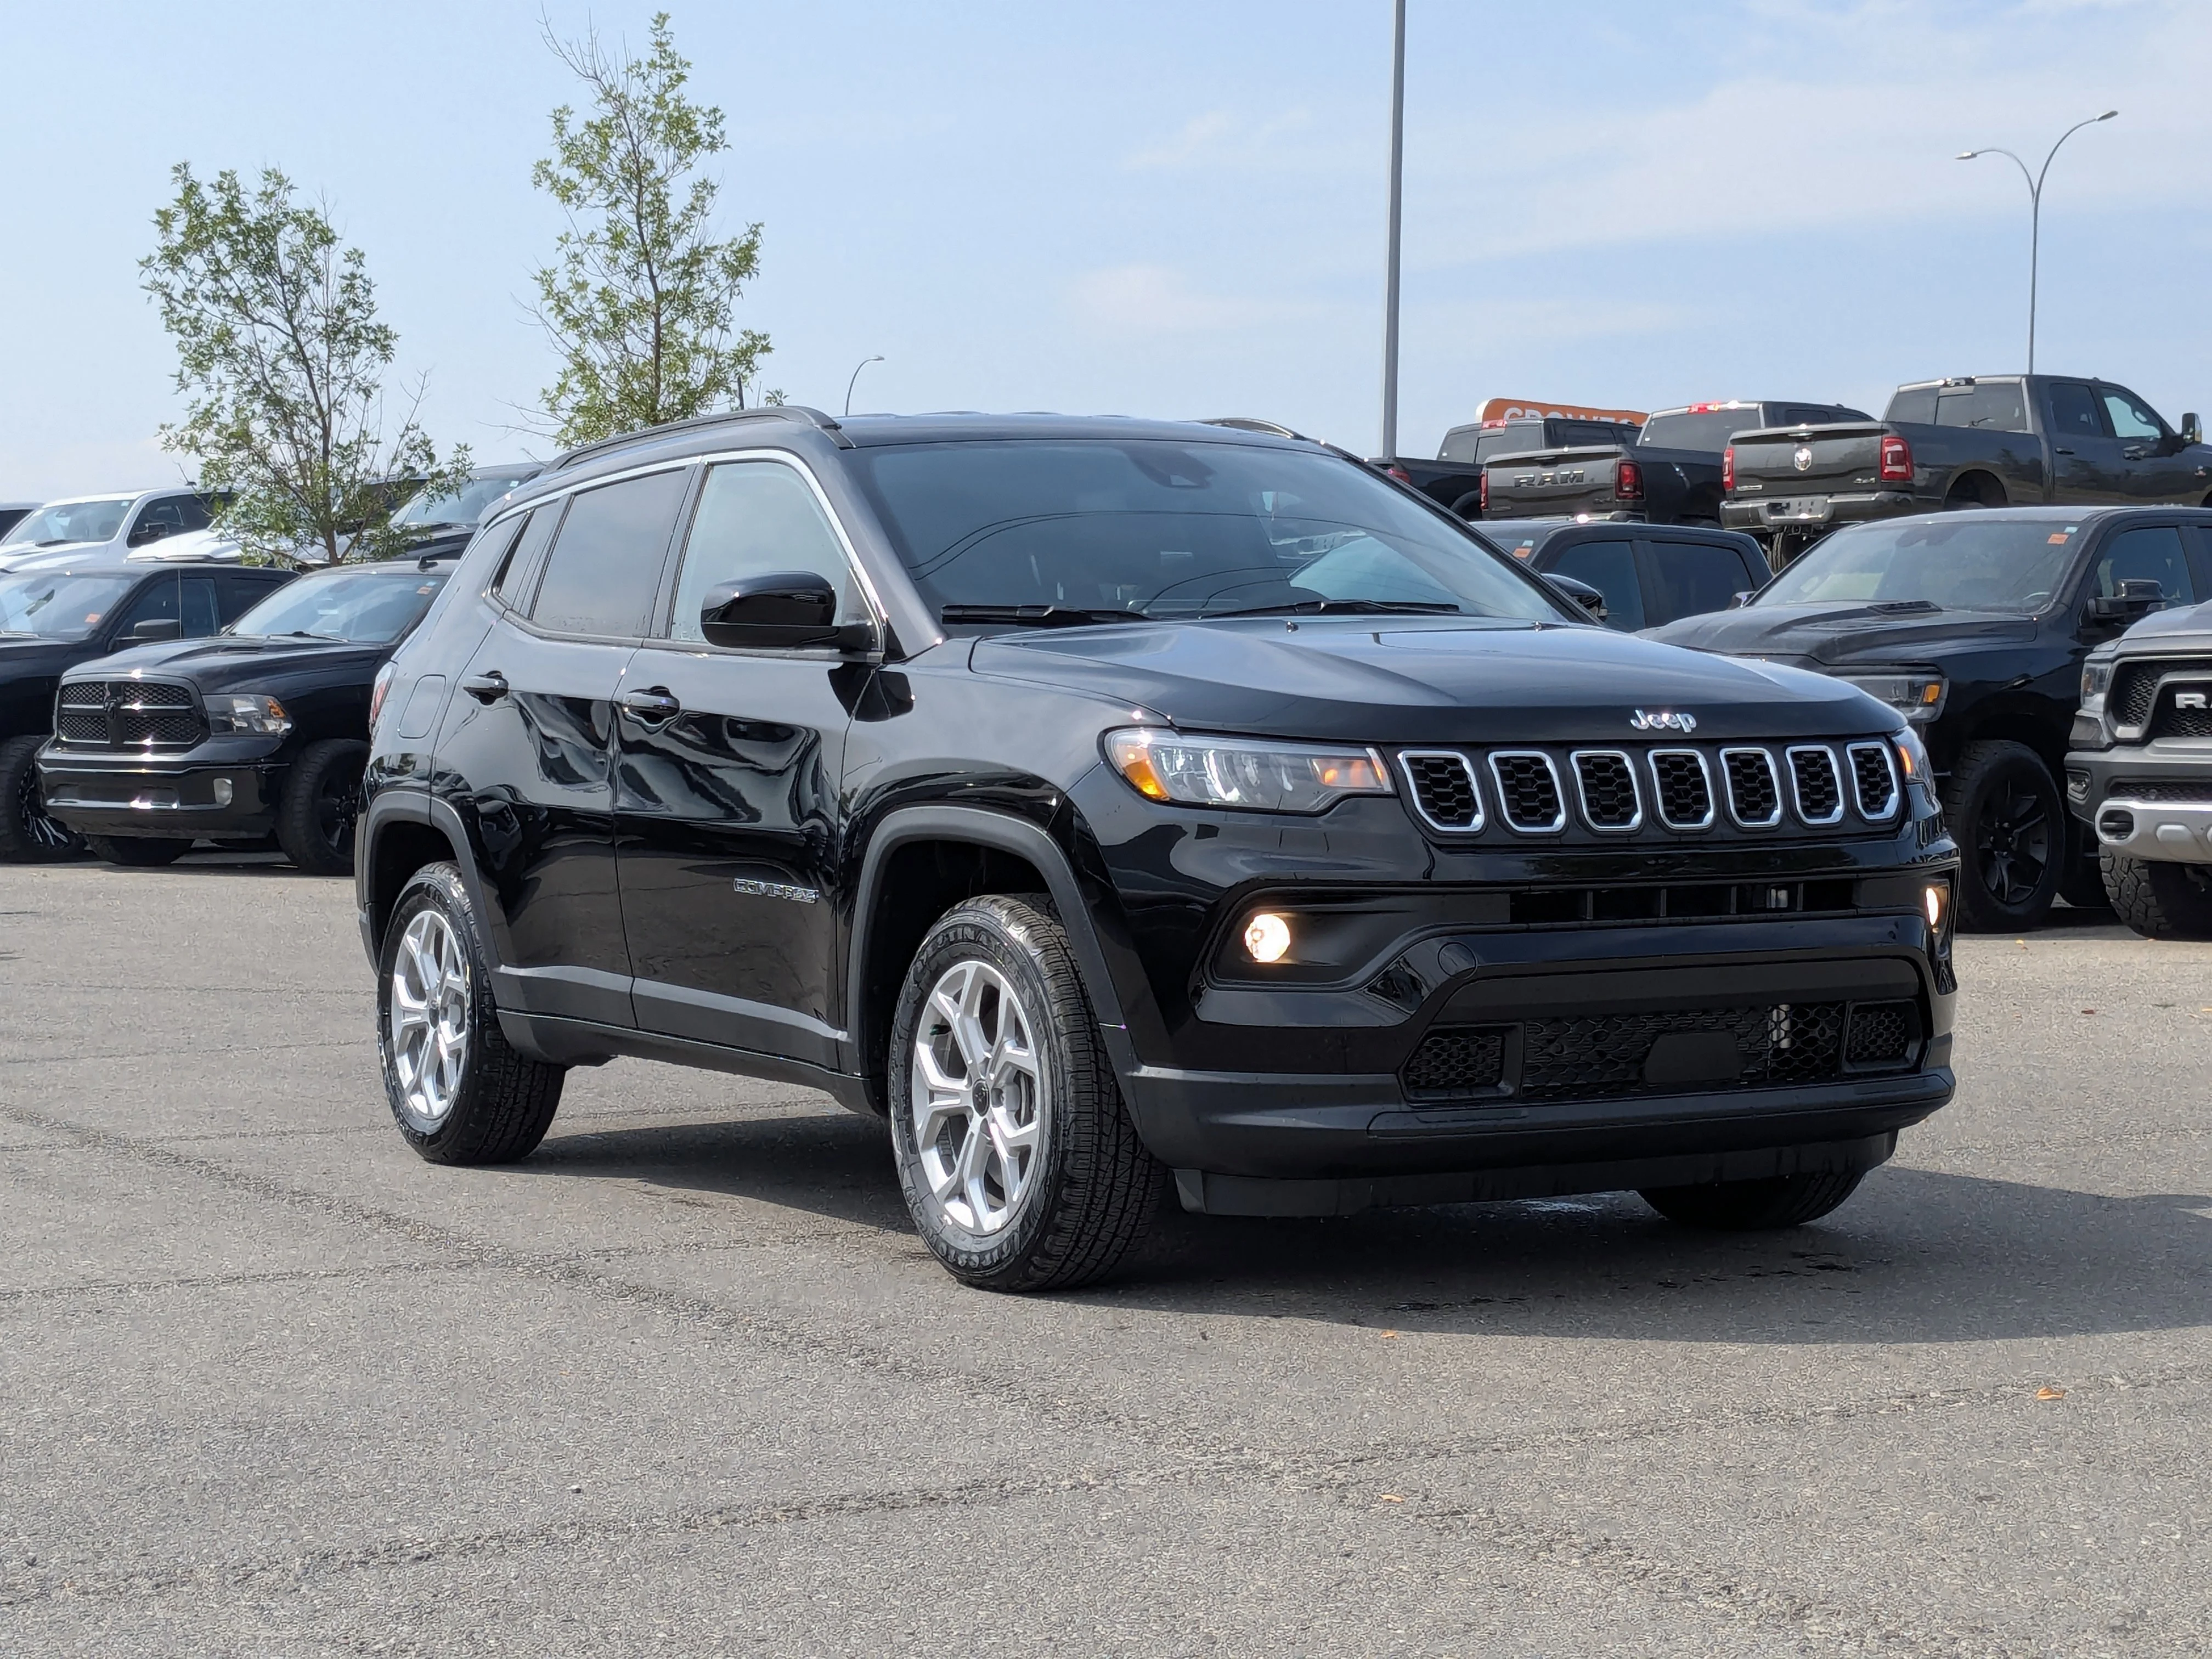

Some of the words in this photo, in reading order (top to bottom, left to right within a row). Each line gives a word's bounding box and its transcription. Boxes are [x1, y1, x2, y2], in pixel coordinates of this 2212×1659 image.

[1514, 470, 1584, 487] RAM
[2175, 693, 2212, 708] R
[1630, 709, 1697, 733] Jeep
